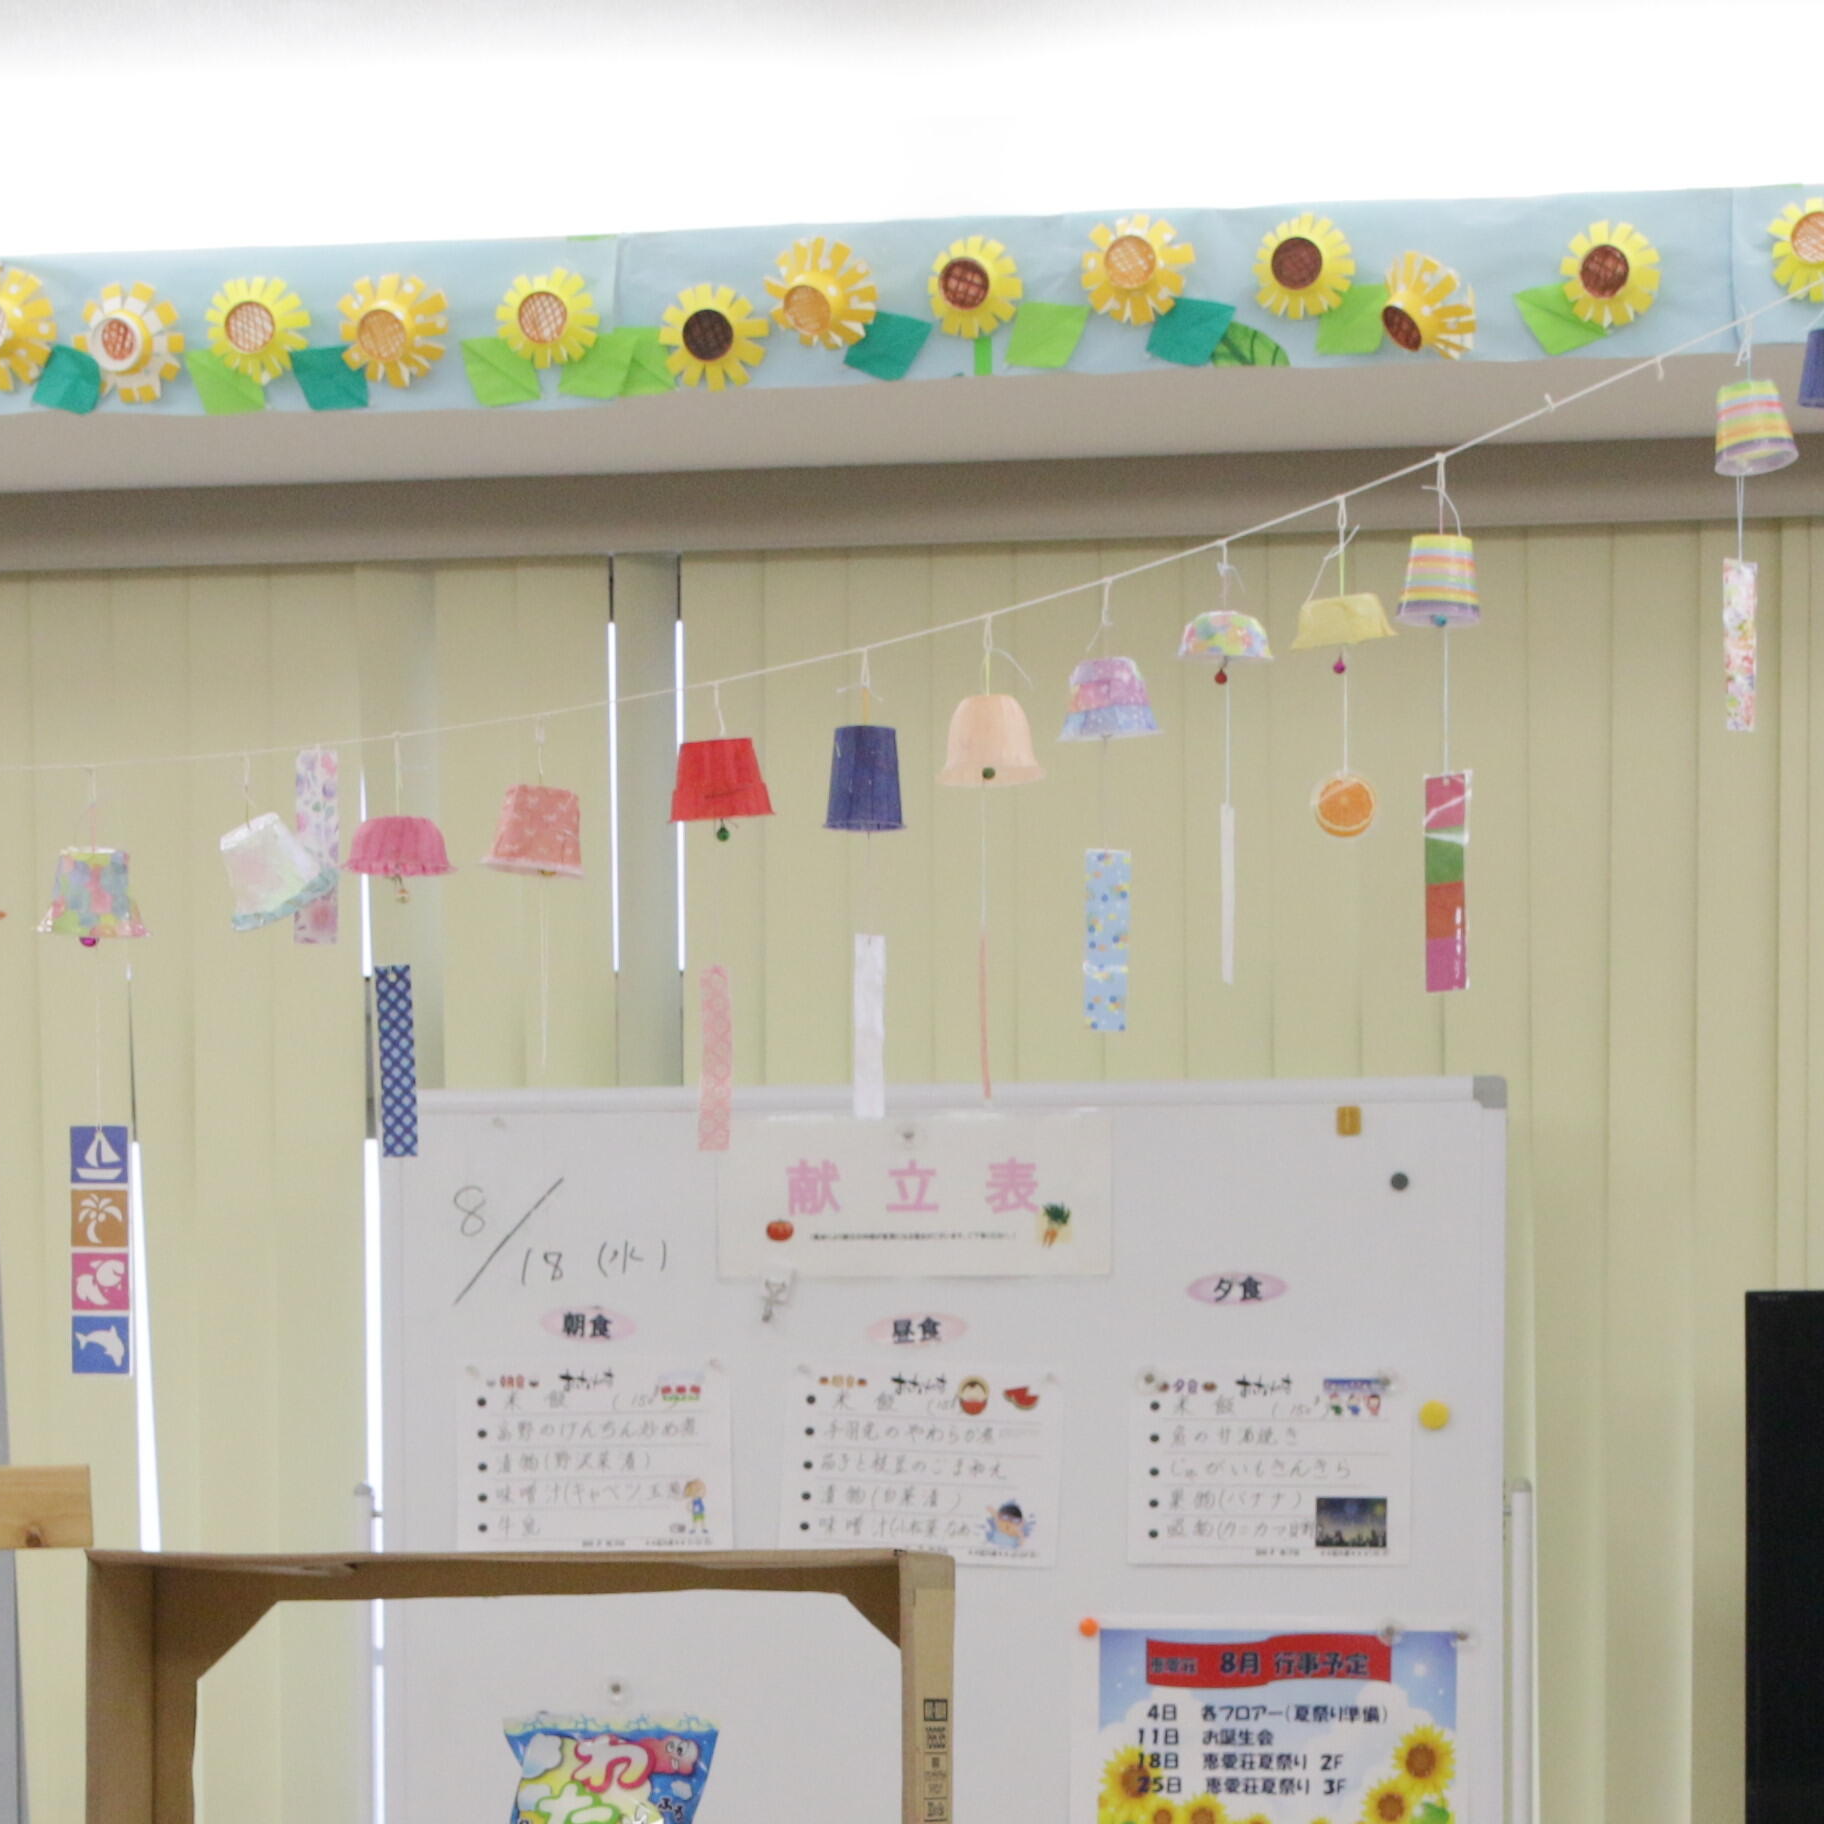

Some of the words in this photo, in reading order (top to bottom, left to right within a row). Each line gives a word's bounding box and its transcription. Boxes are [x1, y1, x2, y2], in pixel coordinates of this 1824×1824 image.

[786, 1157, 1039, 1216] 献立表
[1214, 1275, 1262, 1302] 夕食
[563, 1312, 611, 1338] 朝食
[892, 1316, 942, 1344] 昼食
[1219, 1651, 1260, 1675] 8月
[1273, 1651, 1370, 1676] 行事予定
[1147, 1704, 1177, 1722] 4日
[1137, 1728, 1180, 1746] 11日
[1201, 1728, 1275, 1747] お誕生会
[1137, 1753, 1180, 1770] 18日
[1320, 1753, 1344, 1771] 2F
[1137, 1776, 1182, 1795] 25日
[1323, 1777, 1347, 1795] 3F
